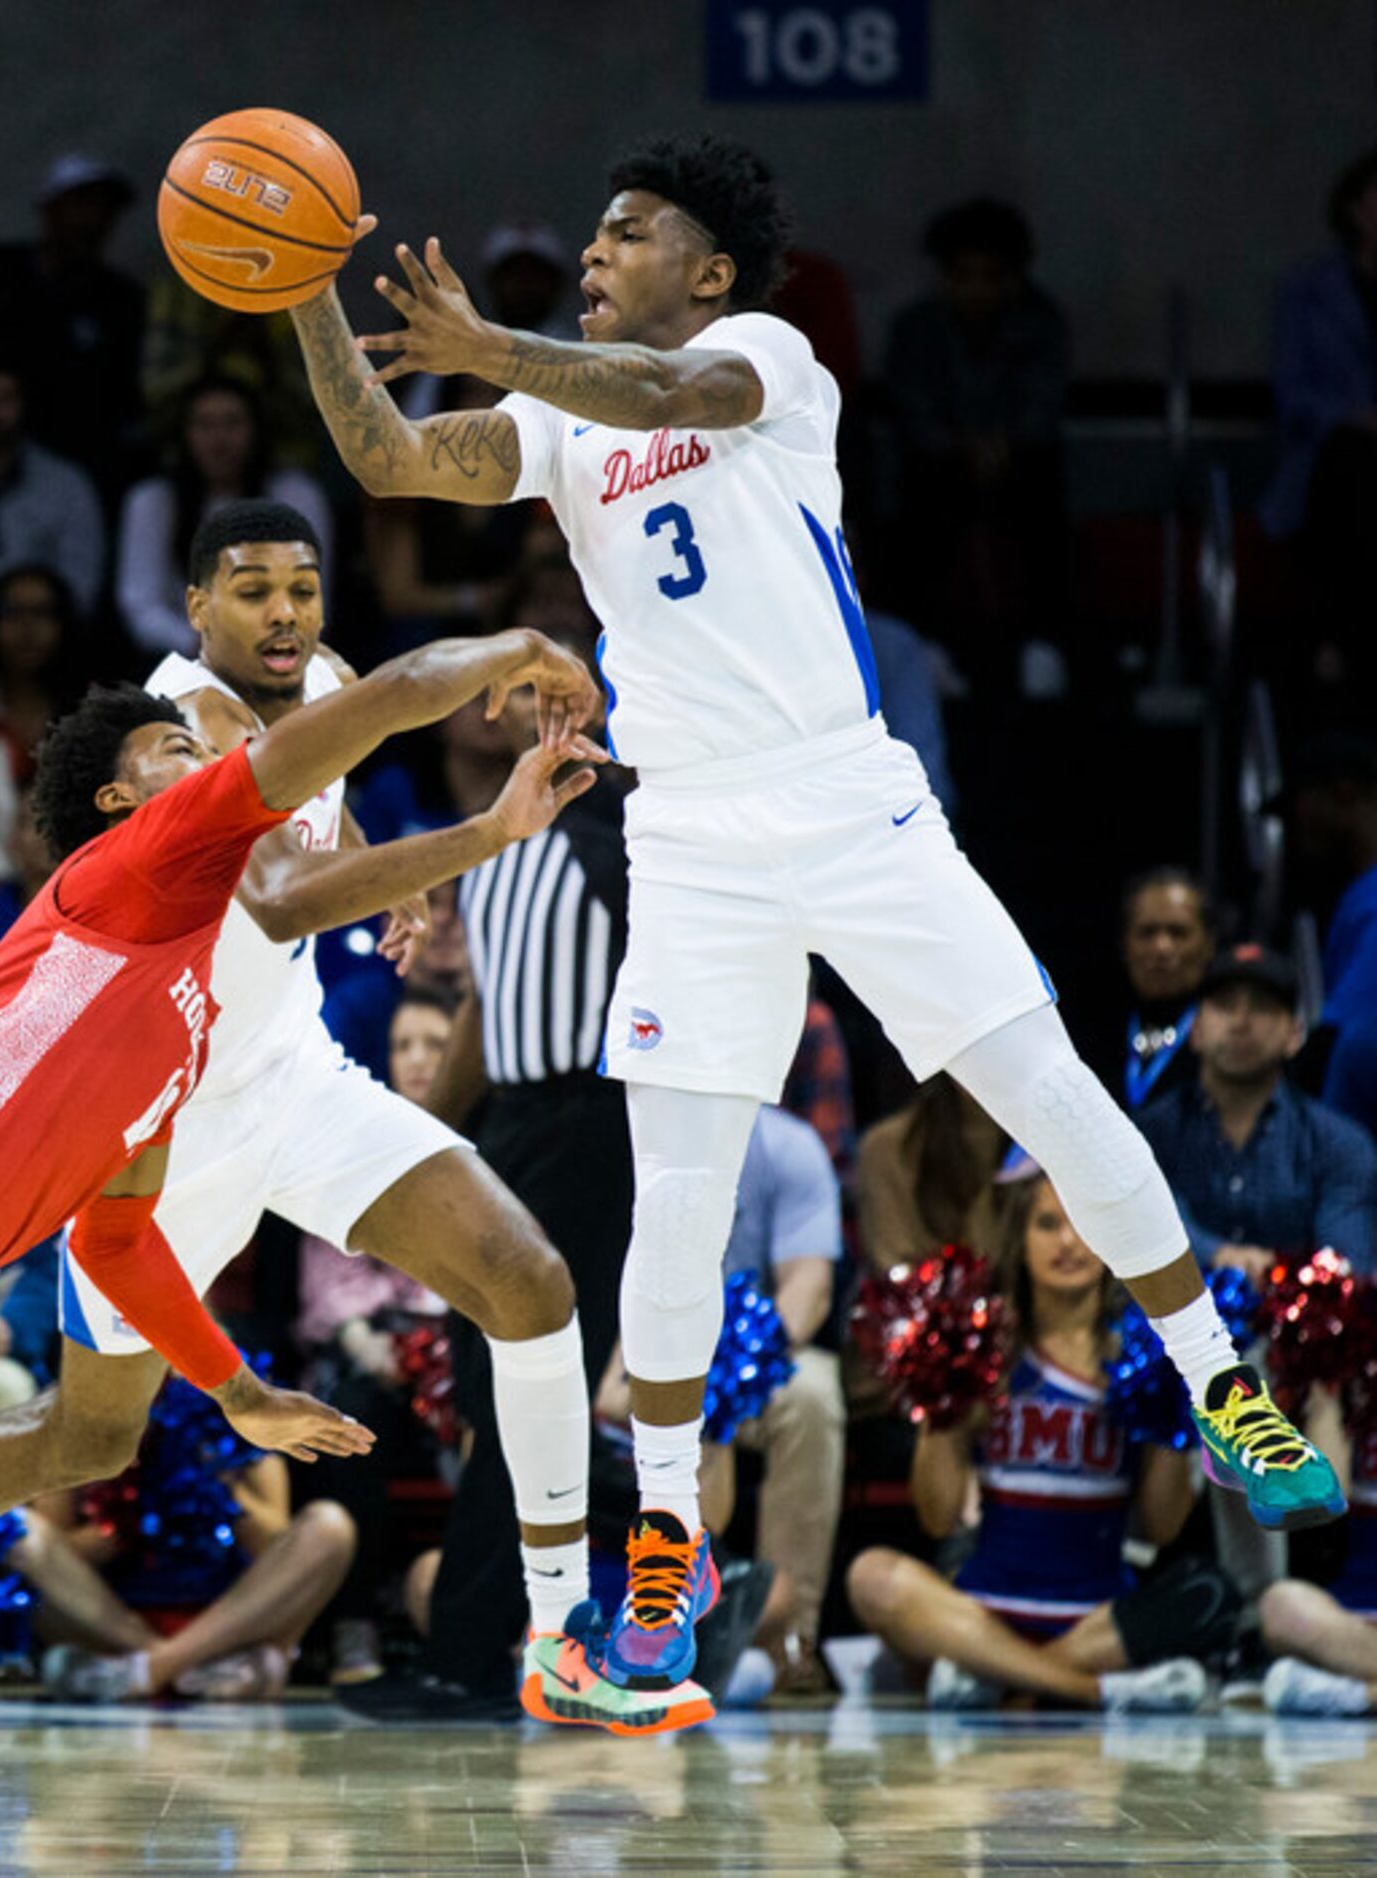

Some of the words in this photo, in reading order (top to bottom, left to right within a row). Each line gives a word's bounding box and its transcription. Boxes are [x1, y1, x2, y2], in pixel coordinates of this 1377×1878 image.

[734, 6, 902, 88] 108
[600, 427, 711, 506] Dallas
[643, 501, 708, 601] 3
